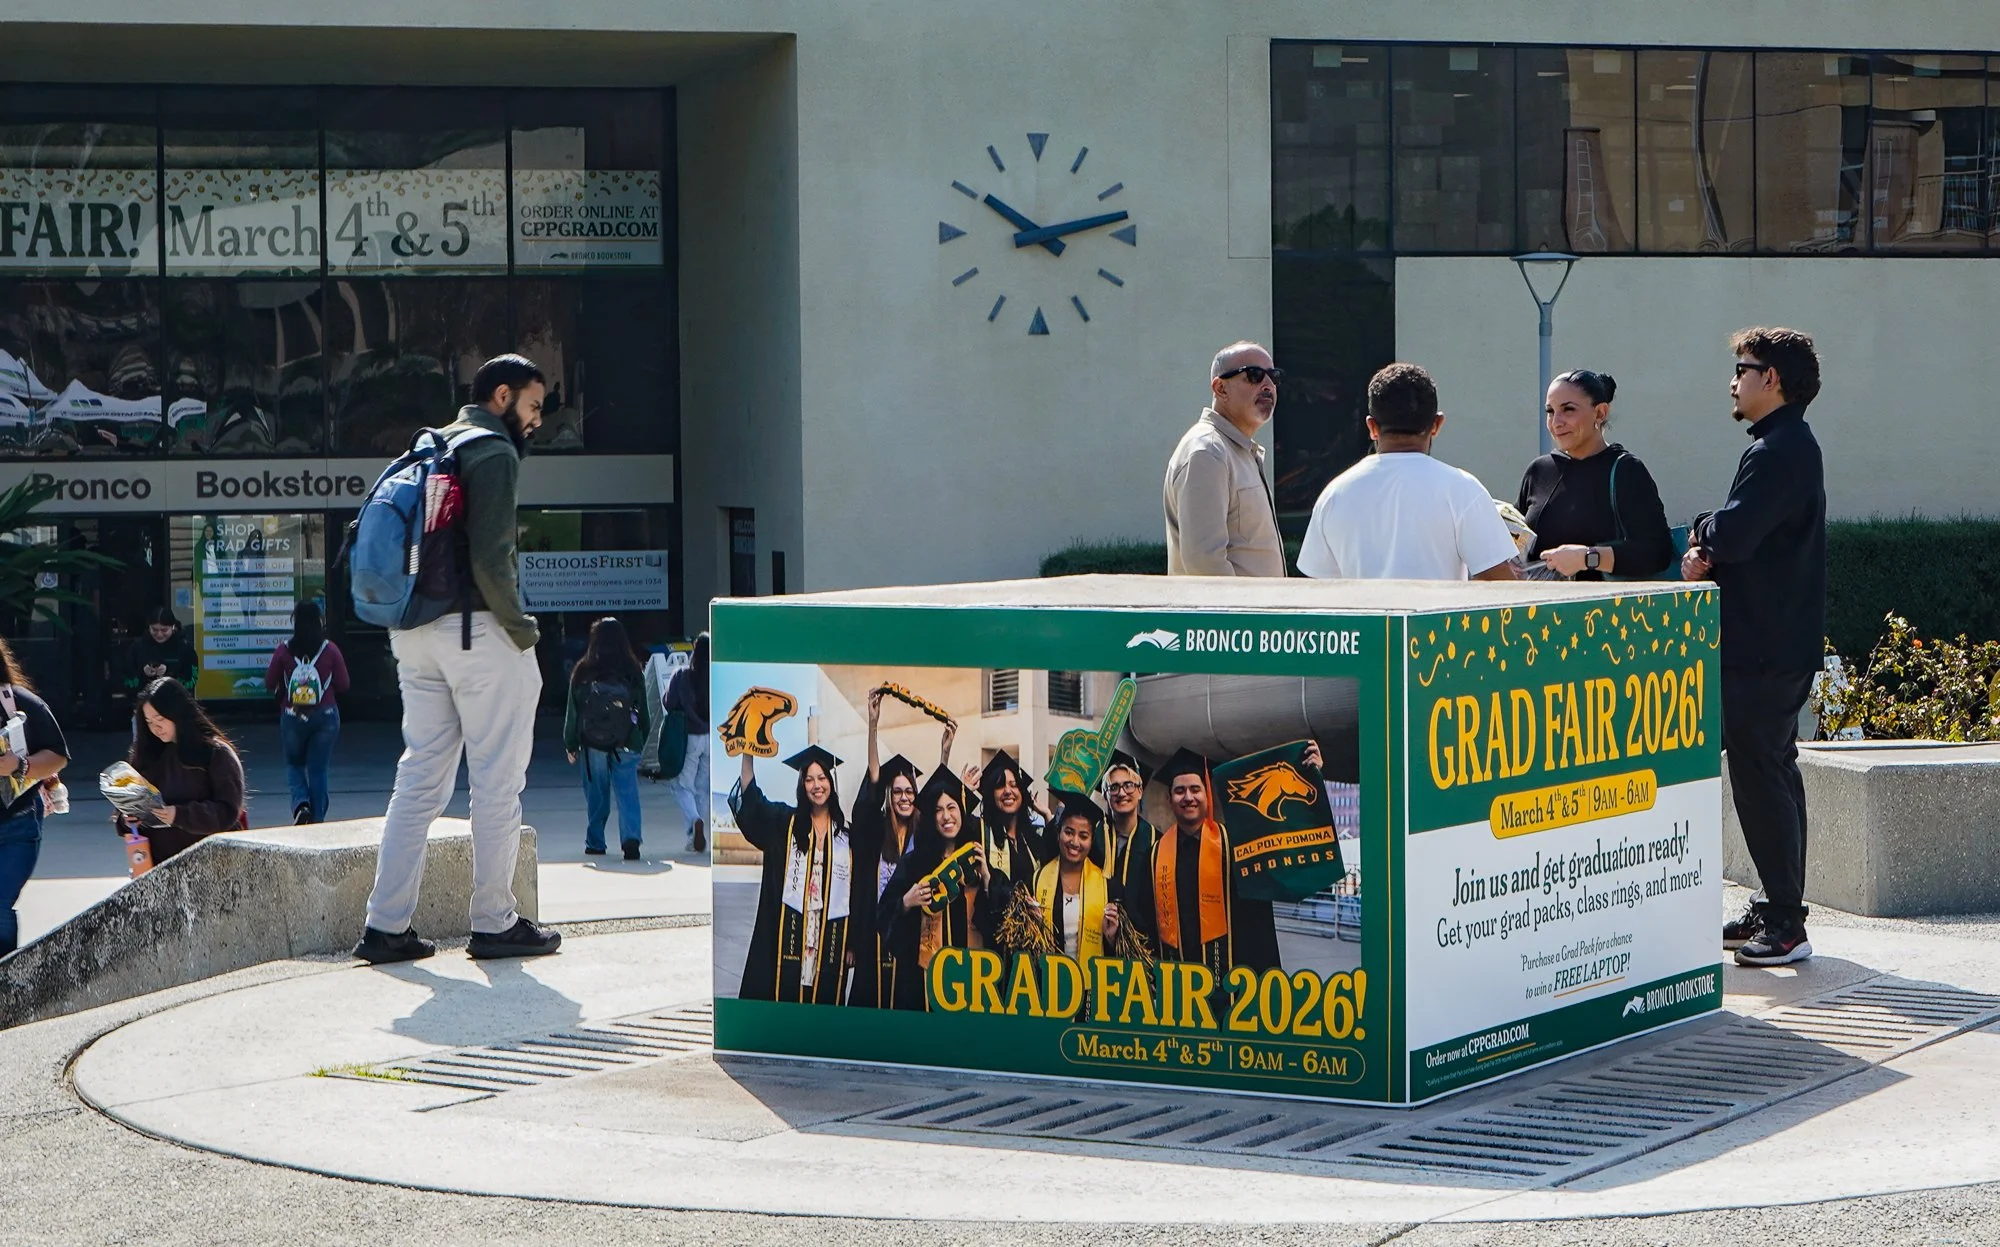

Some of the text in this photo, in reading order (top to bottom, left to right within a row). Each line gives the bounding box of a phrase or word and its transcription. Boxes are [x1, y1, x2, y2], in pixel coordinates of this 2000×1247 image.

[0, 190, 496, 258] FAIR! March 4th & 5th
[520, 205, 659, 219] ORDER ONLINE AT
[520, 221, 659, 237] CPPGRAD.COM
[571, 251, 632, 260] BRONCO BOOKSTORE
[196, 470, 366, 498] Bookstore
[205, 538, 290, 552] GRAD GIFTS
[216, 523, 256, 536] SHOP
[525, 580, 554, 588] Serving
[555, 579, 580, 587] school
[582, 578, 622, 588] employees
[624, 578, 643, 586] since
[550, 599, 594, 607] BOOKSTORE
[637, 598, 662, 606] FLOOR
[1185, 629, 1361, 655] BRONCO BOOKSTORE
[1429, 659, 1705, 790] GRAD FAIR 2026!
[1500, 795, 1544, 830] March
[1546, 789, 1562, 821] 4th
[1561, 796, 1570, 818] &
[1571, 784, 1586, 816] 5th
[1593, 785, 1618, 812] 9AM
[1626, 779, 1649, 805] 6AM
[1236, 830, 1331, 858] CAL POLY POMONA
[792, 839, 802, 892] ONCOS
[1241, 850, 1335, 877] BRONCOS
[1452, 820, 1690, 907] Join us and get graduation ready!
[1437, 859, 1702, 949] Get your grad packs, class rings, and more!
[1555, 953, 1560, 963] a
[1561, 942, 1579, 961] Grad
[1579, 937, 1595, 956] Pack
[1594, 936, 1606, 955] for
[1605, 939, 1609, 948] a
[1610, 931, 1633, 948] chance
[1525, 951, 1631, 999] to win a FREE LAPTOP!
[932, 949, 1368, 1041] GRAD FAIR 2026!
[1646, 973, 1715, 1012] BRONCO BOOKSTORE
[1077, 1033, 1148, 1061] March
[1152, 1036, 1179, 1062] 4th
[1179, 1043, 1195, 1065] &
[1197, 1038, 1224, 1065] 5th
[1239, 1048, 1284, 1071] 9AM
[1303, 1050, 1348, 1076] 6AM
[1425, 1023, 1530, 1069] Order now at CPPGRAD.COM
